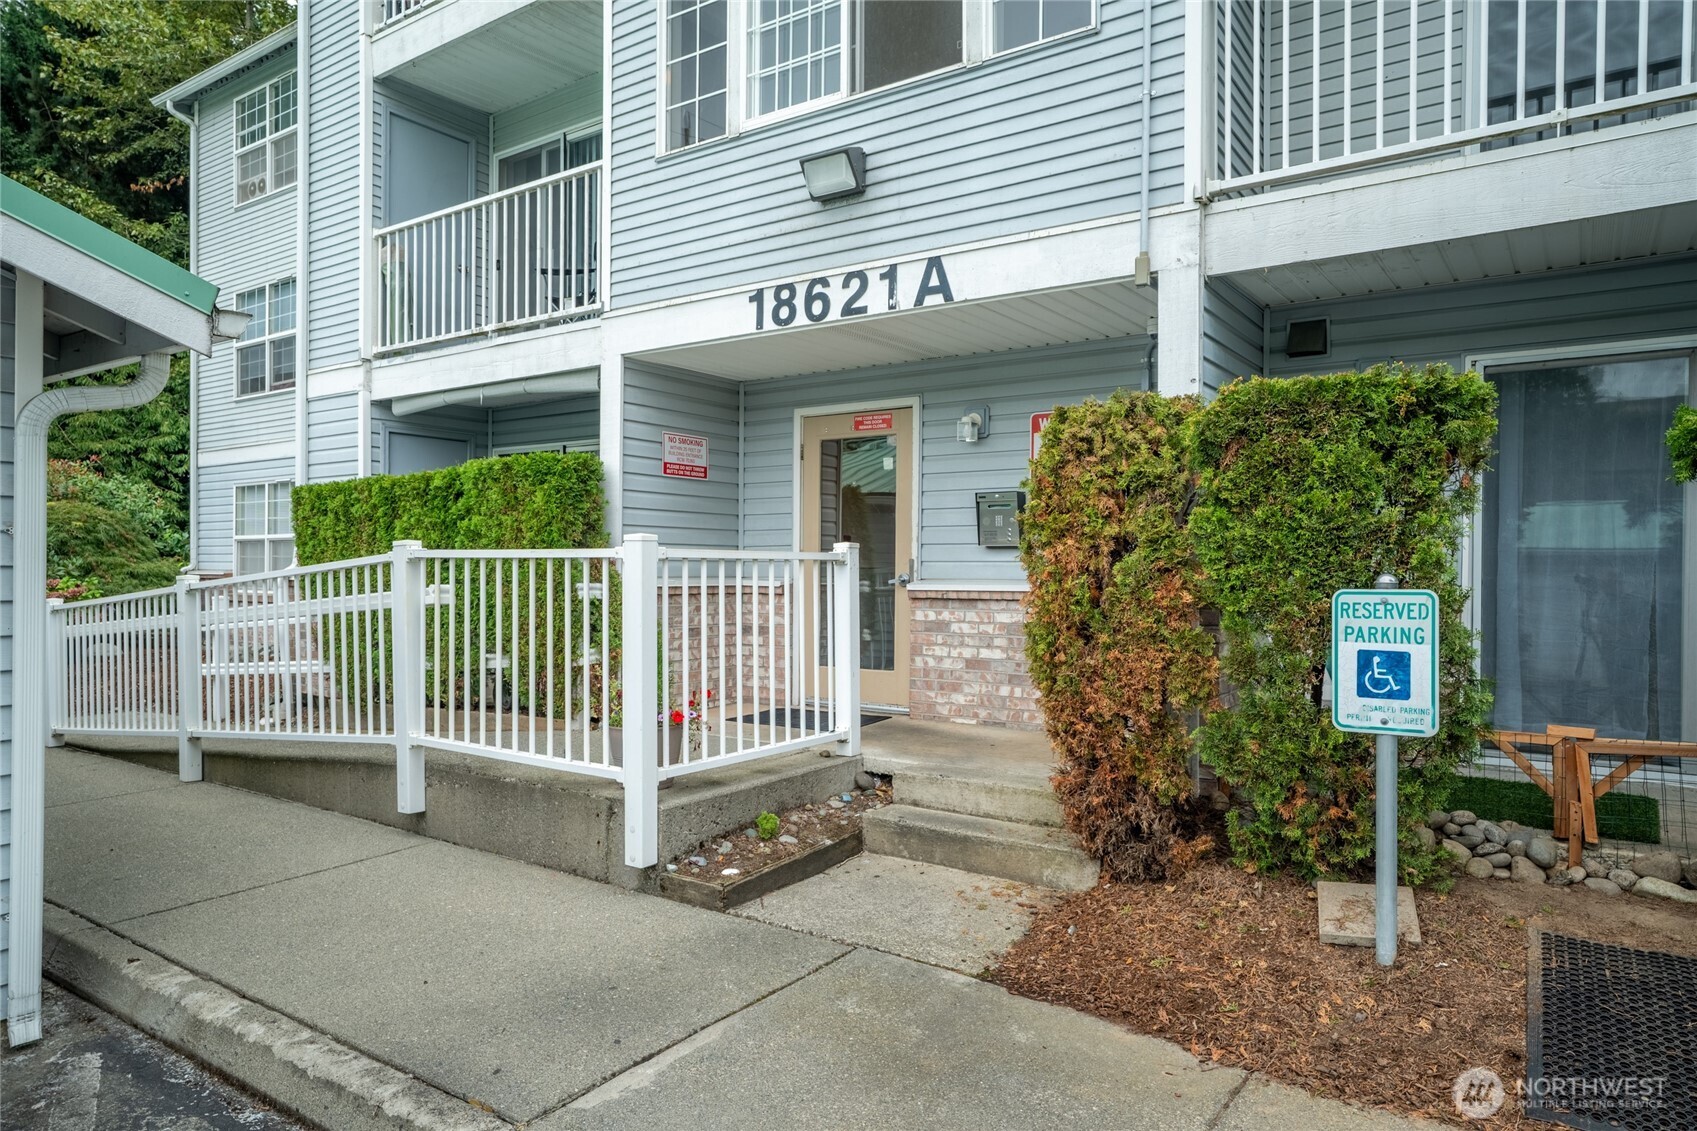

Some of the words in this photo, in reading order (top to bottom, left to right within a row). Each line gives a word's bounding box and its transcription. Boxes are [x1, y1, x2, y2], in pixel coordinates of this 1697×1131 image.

[678, 438, 703, 447] SMOKING
[1340, 602, 1429, 620] RESERVED
[1344, 626, 1425, 645] PARKING
[1400, 707, 1430, 716] PARKING
